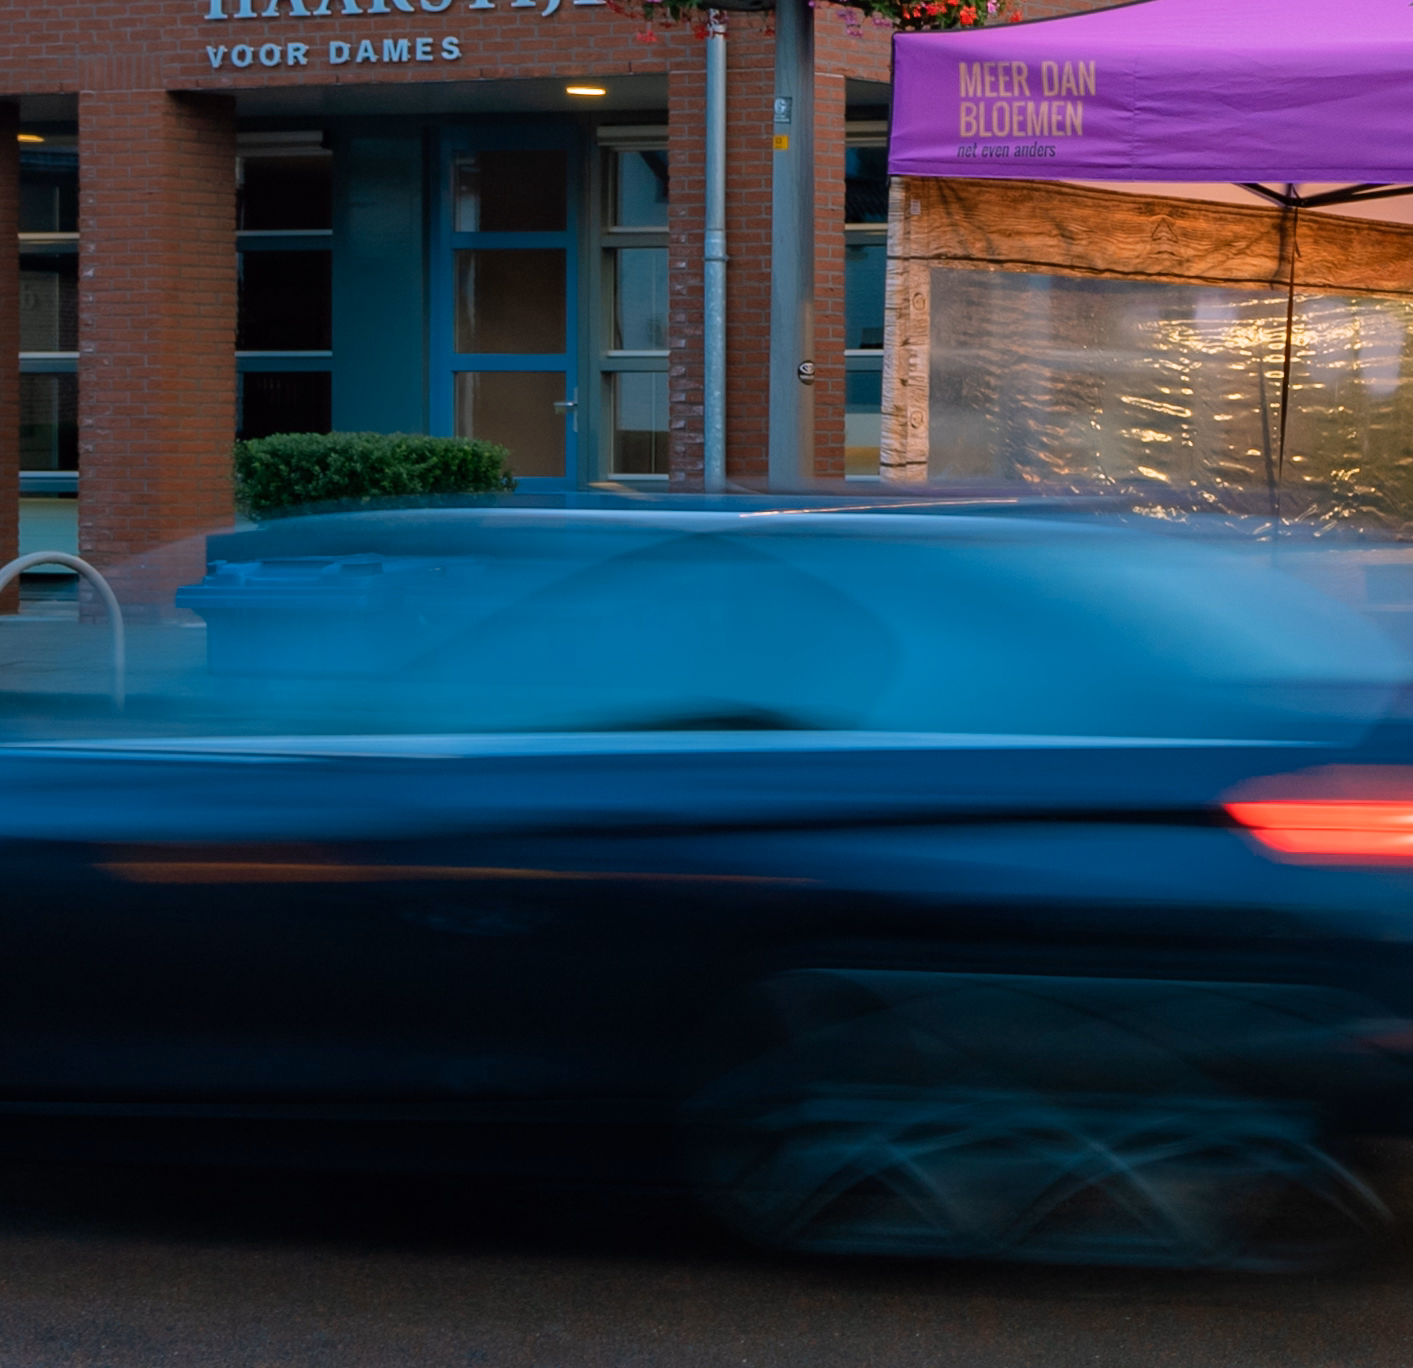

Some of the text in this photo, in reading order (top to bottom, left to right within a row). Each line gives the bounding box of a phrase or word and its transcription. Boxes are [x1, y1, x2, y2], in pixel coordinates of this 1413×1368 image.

[206, 36, 462, 68] VOOR DAMES
[959, 60, 1096, 98] MEER DAN
[959, 100, 1083, 138] BLOEMEN
[957, 141, 1056, 158] net even anders
